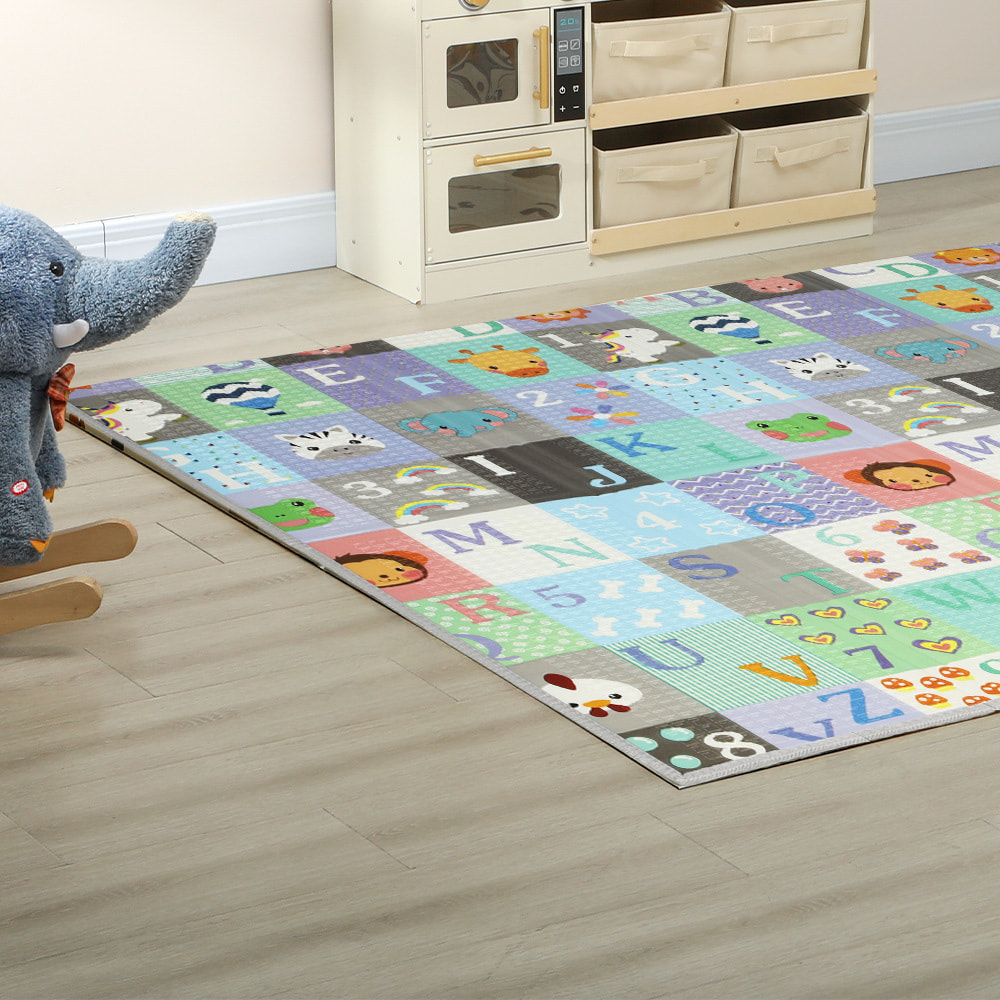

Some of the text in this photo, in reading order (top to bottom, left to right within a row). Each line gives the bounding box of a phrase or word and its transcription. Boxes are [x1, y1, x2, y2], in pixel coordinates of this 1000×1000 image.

[876, 262, 939, 278] D
[665, 289, 728, 307] B
[774, 300, 832, 320] E
[853, 307, 901, 327] F
[538, 333, 584, 349] 1
[296, 363, 365, 388] E
[393, 373, 448, 396] F
[636, 367, 697, 389] G
[942, 377, 995, 397] I
[516, 391, 562, 409] 2
[713, 381, 796, 405] H
[845, 398, 893, 416] 3
[600, 432, 678, 458] K
[695, 442, 768, 463] L
[201, 461, 287, 490] H
[464, 455, 516, 476] I
[583, 465, 627, 488] J
[343, 480, 392, 500] 3
[751, 469, 810, 494] P
[636, 511, 682, 530] 4
[745, 502, 816, 526] O
[421, 520, 523, 554] M
[815, 526, 862, 546] 6
[523, 537, 610, 568] N
[668, 554, 739, 580] S
[780, 567, 853, 596] T
[531, 584, 586, 608] 5
[437, 593, 531, 624] R
[619, 638, 707, 672] U
[842, 645, 895, 670] 7
[738, 654, 819, 687] V
[816, 687, 905, 725] Z
[703, 731, 766, 760] 8
